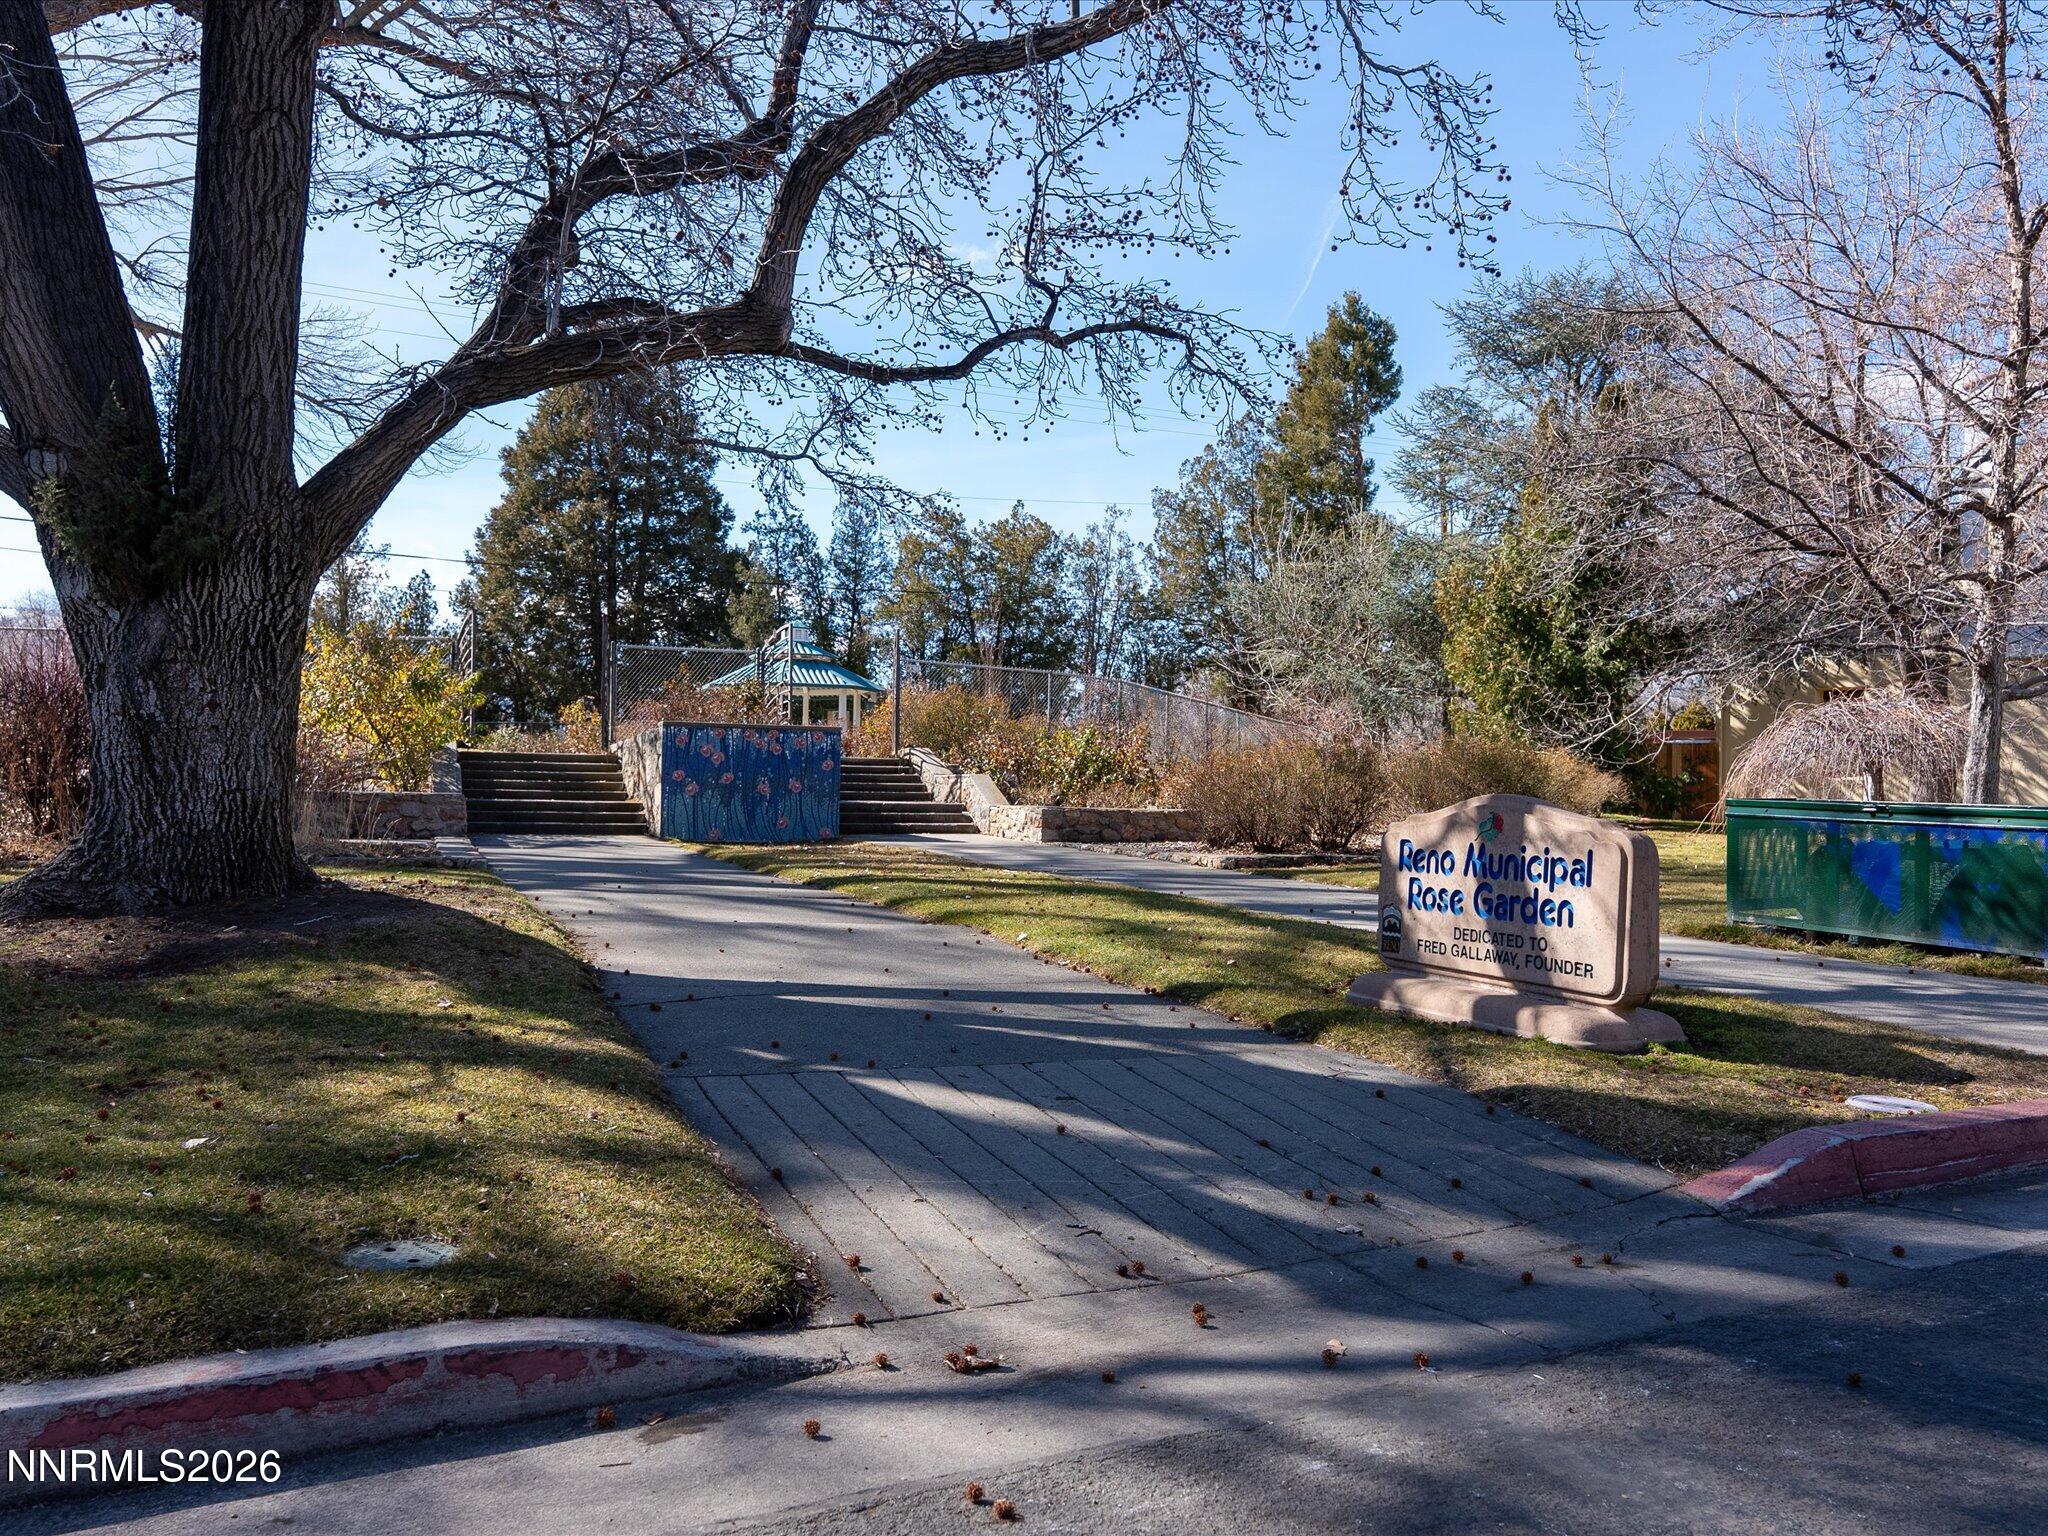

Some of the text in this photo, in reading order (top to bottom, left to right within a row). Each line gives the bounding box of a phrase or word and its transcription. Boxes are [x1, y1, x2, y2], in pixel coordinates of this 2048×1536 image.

[1399, 839, 1593, 892] Reno Municipal
[1408, 877, 1574, 928] Rose Garden
[1417, 939, 1593, 979] FRED GALLAWAY, FOUNDER
[1454, 927, 1548, 952] DEDICATED TO
